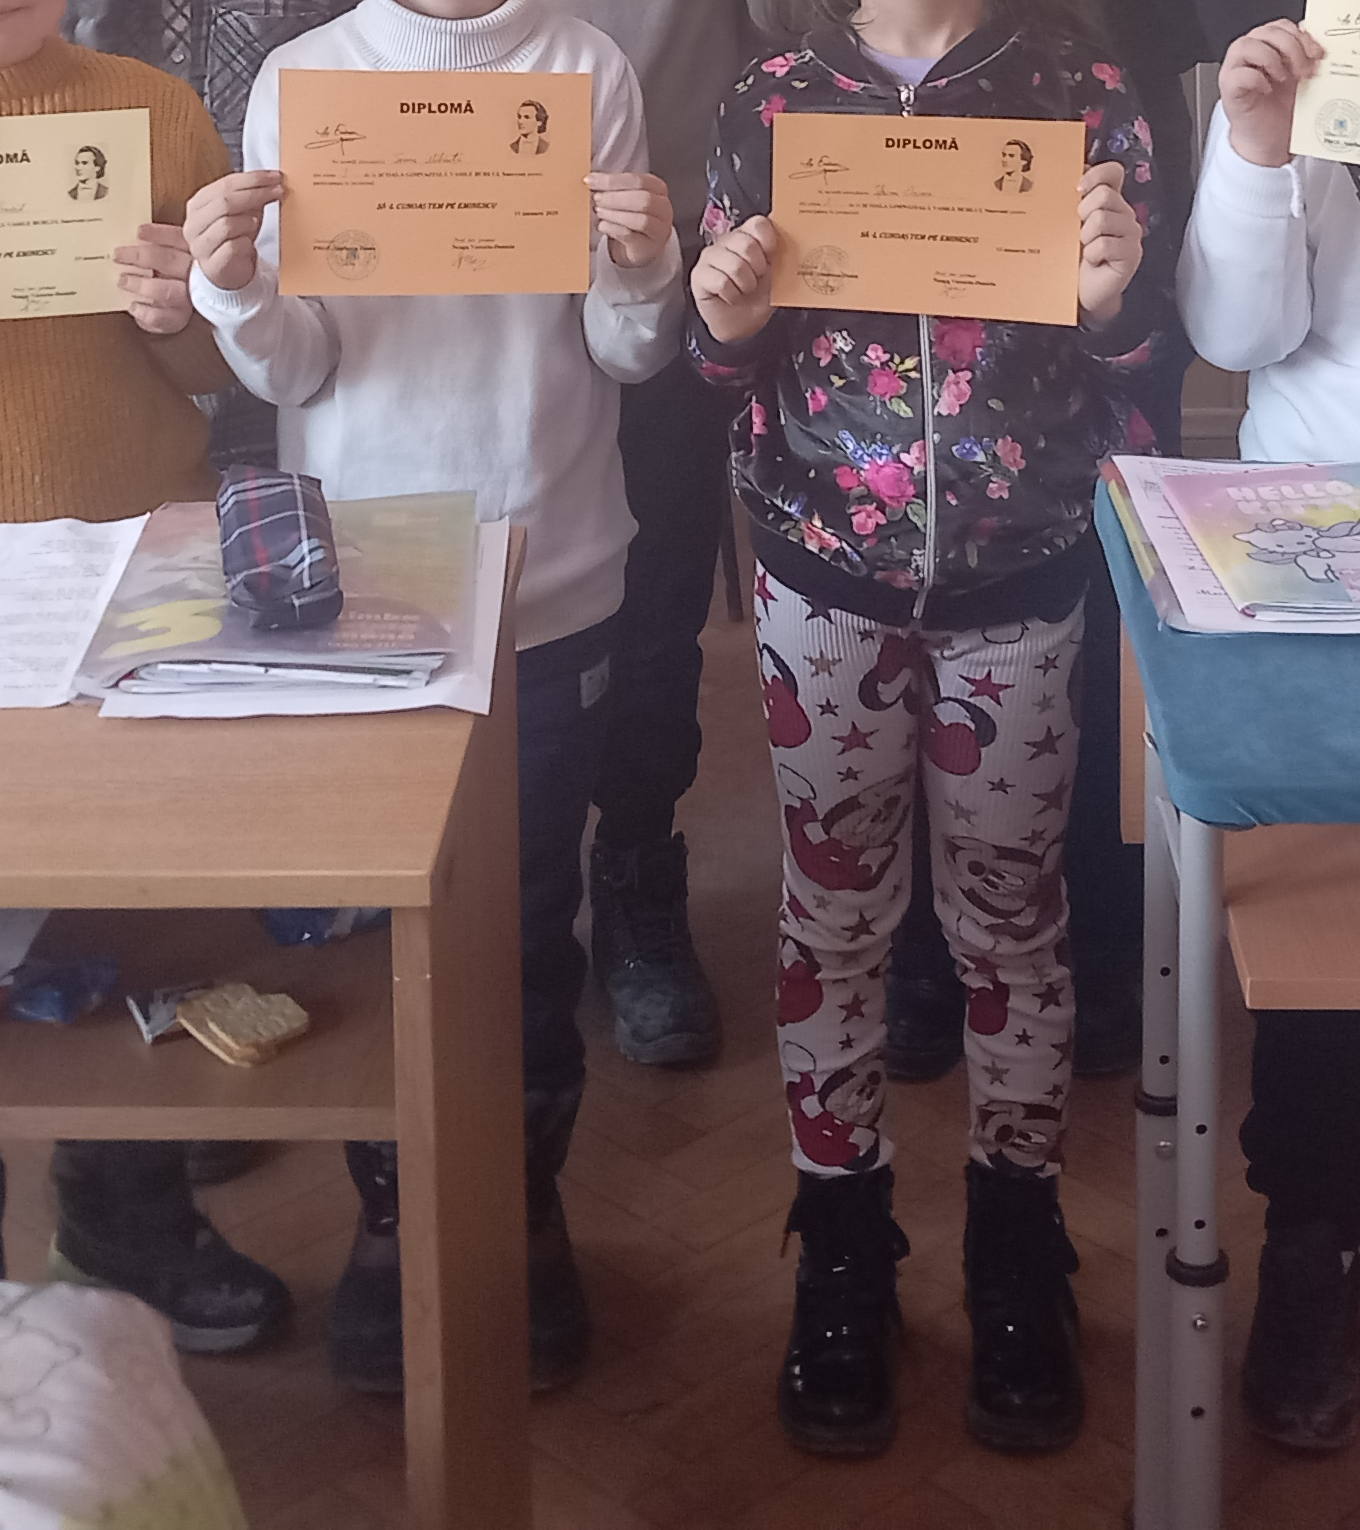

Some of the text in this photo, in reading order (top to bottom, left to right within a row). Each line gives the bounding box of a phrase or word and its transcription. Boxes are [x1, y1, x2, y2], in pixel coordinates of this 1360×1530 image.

[399, 100, 475, 115] DIPLOMĂ
[885, 137, 959, 152] DIPLOMĂ
[1227, 480, 1354, 501] HELLO
